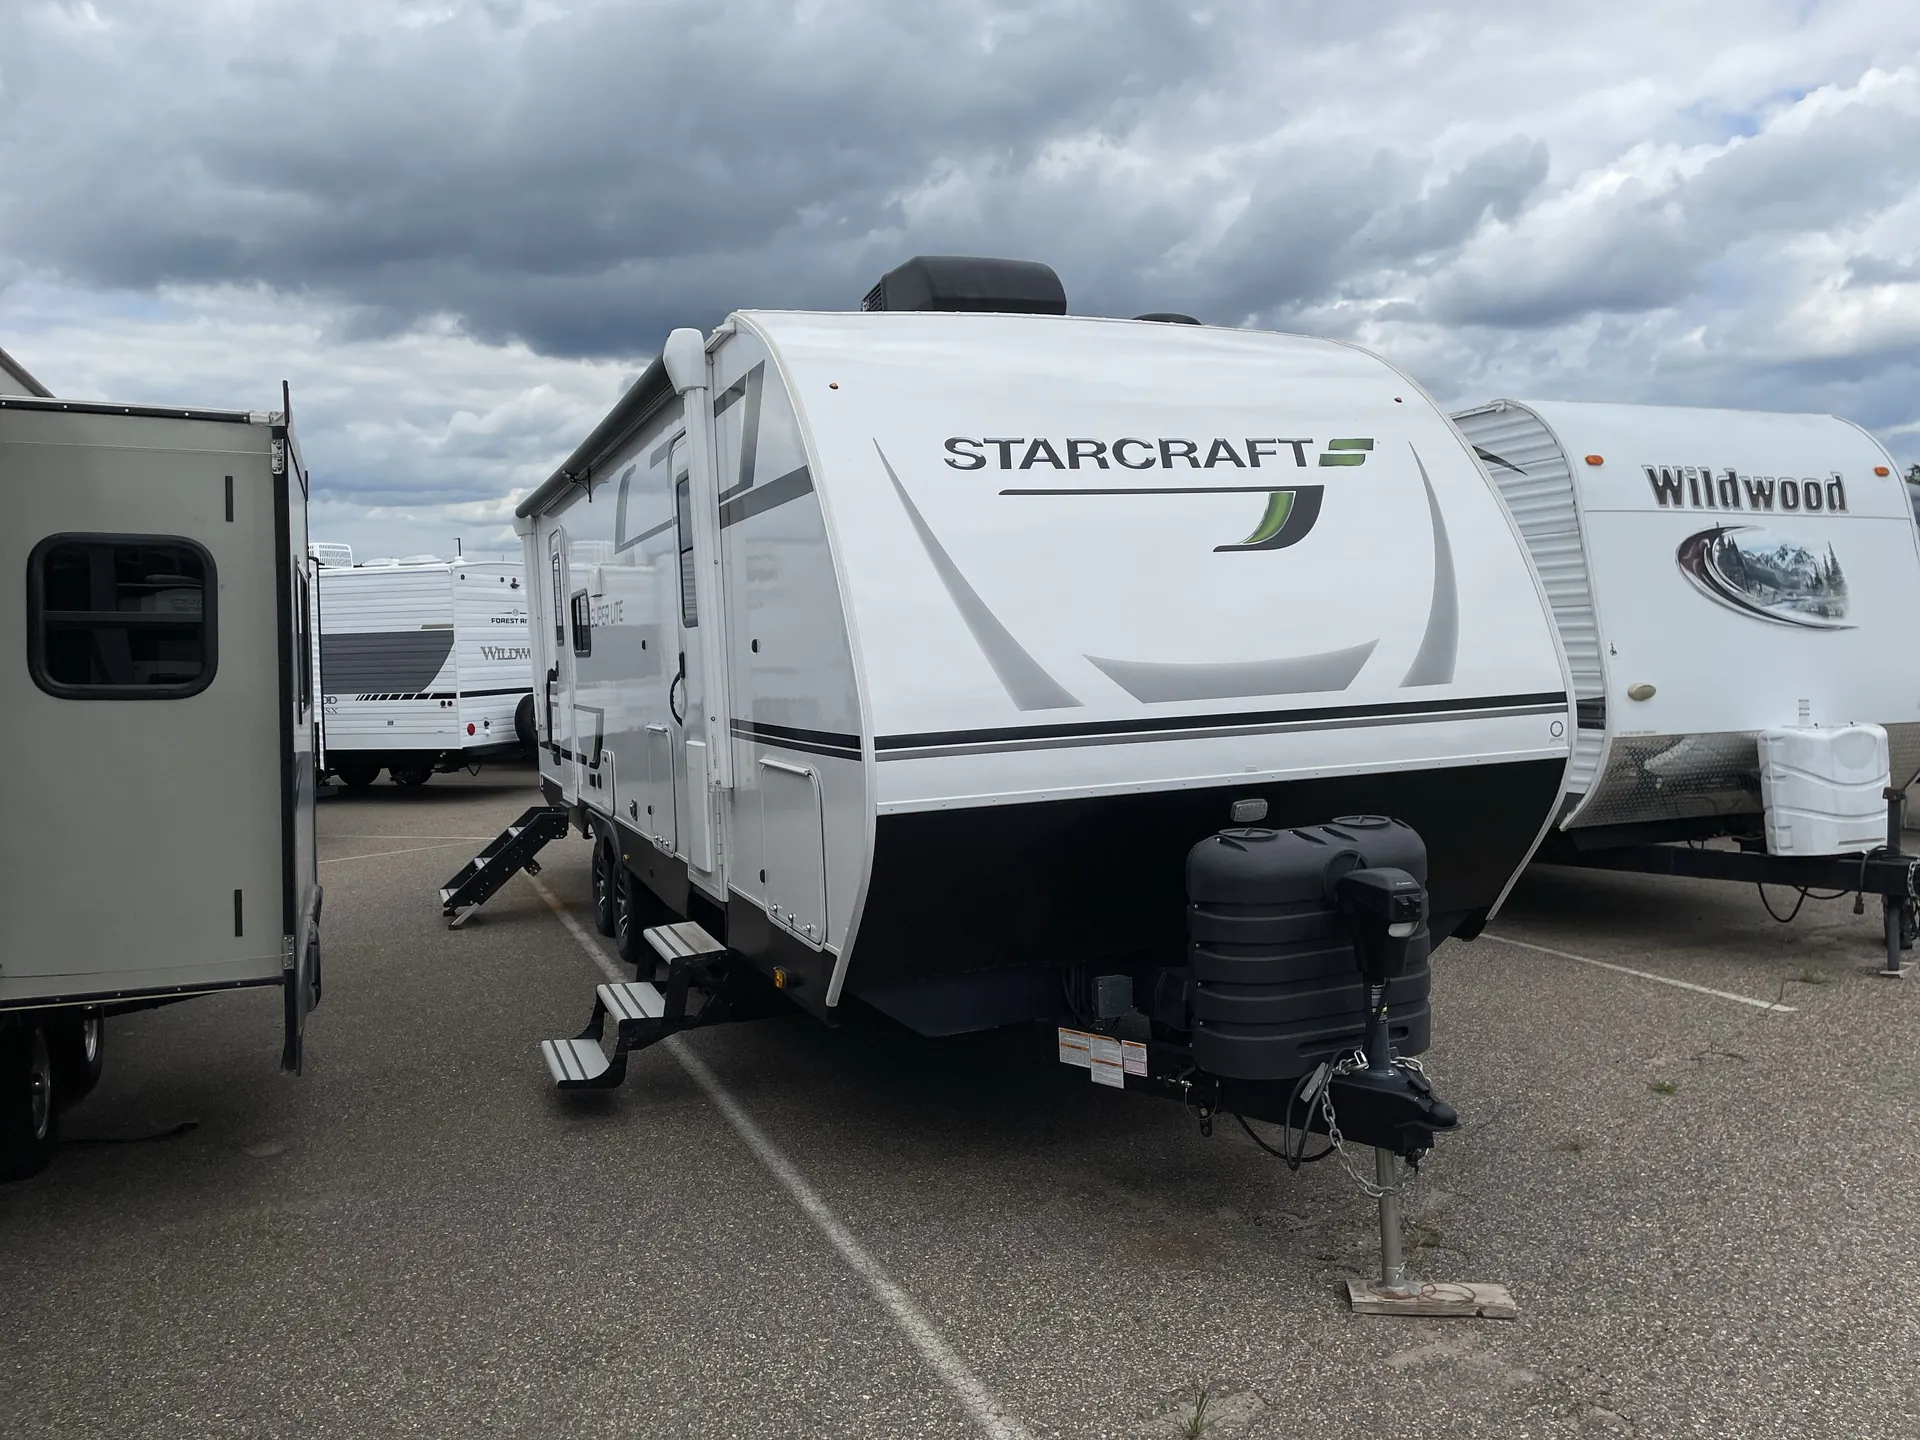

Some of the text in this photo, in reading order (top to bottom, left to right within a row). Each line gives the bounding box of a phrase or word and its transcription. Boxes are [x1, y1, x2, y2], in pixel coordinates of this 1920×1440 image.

[943, 436, 1314, 470] STARCRAFT
[1641, 464, 1849, 513] Wildwood
[480, 646, 531, 660] WILDW
